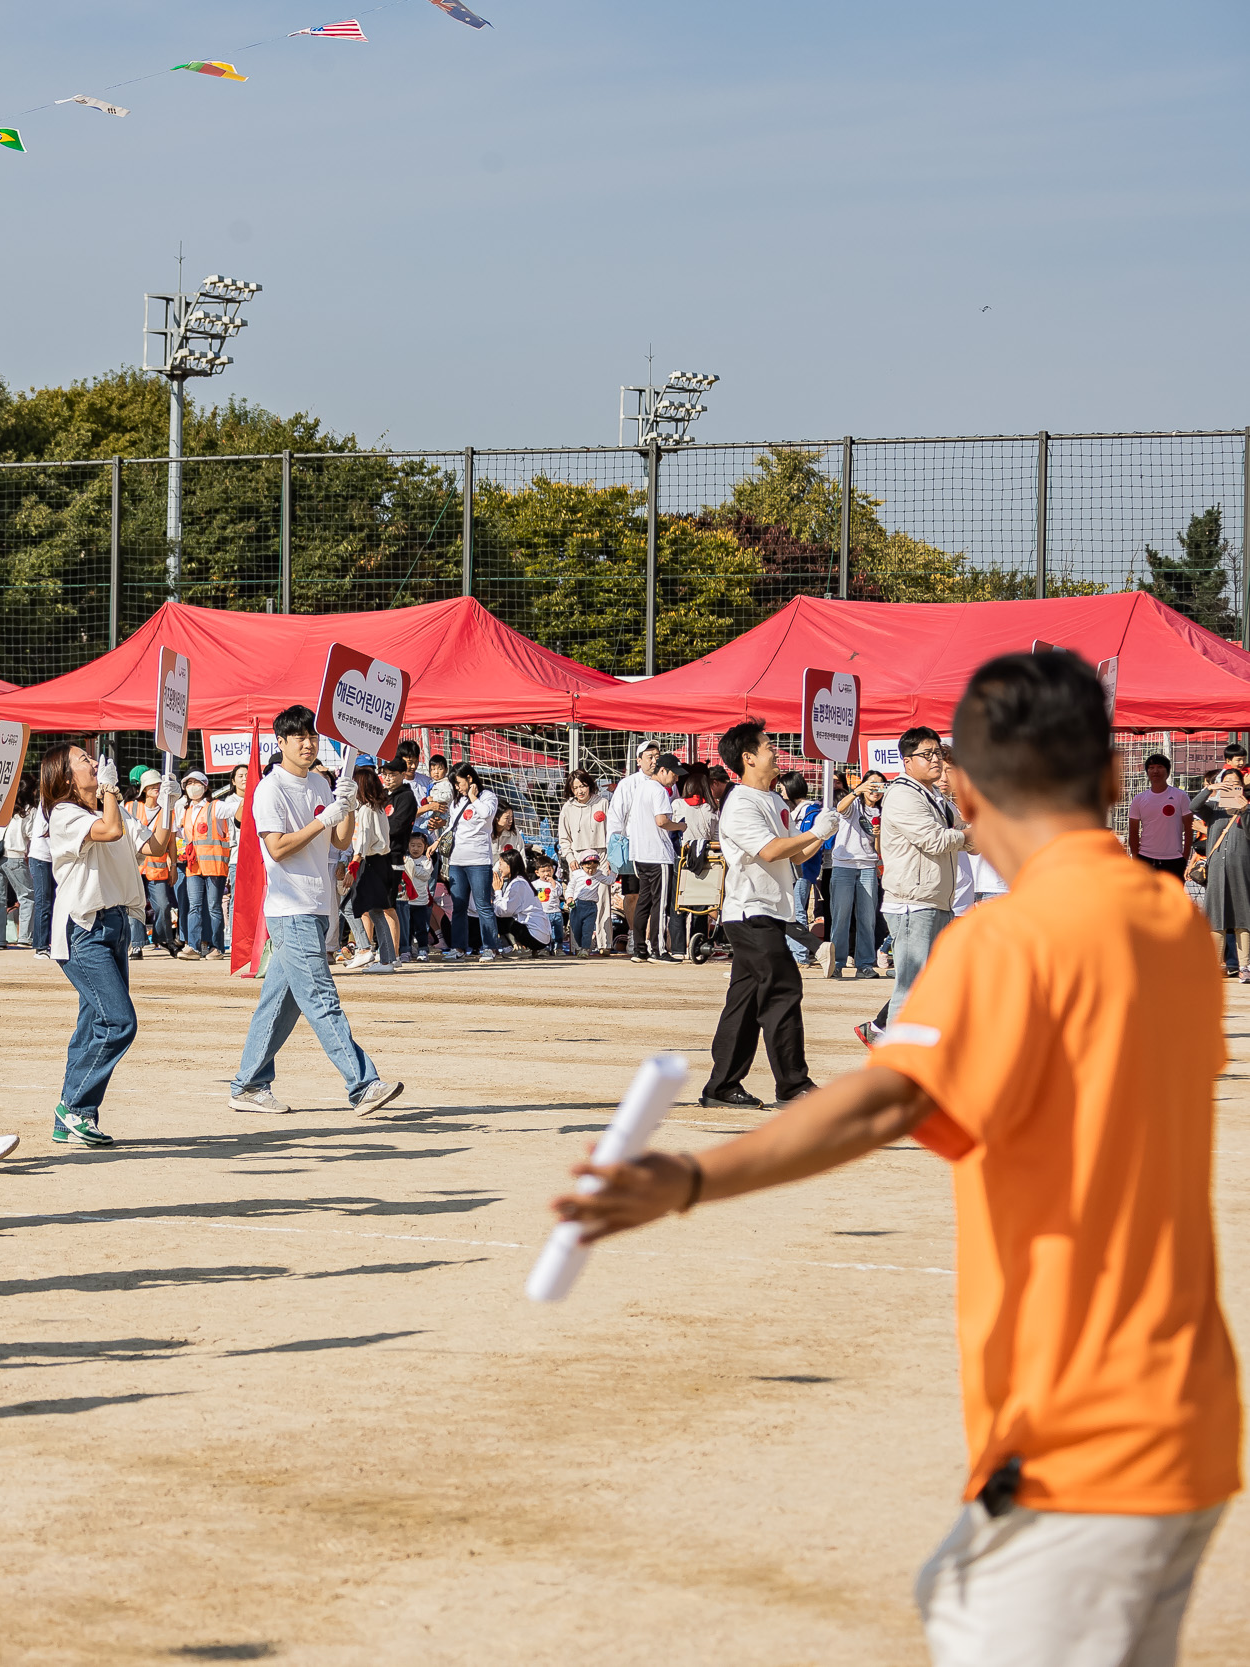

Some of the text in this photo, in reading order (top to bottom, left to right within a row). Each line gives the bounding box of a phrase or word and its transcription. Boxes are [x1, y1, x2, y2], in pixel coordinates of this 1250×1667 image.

[336, 679, 396, 722] 해든어린이집
[813, 703, 853, 726] 늘평화어린이집
[874, 748, 903, 765] 해든
